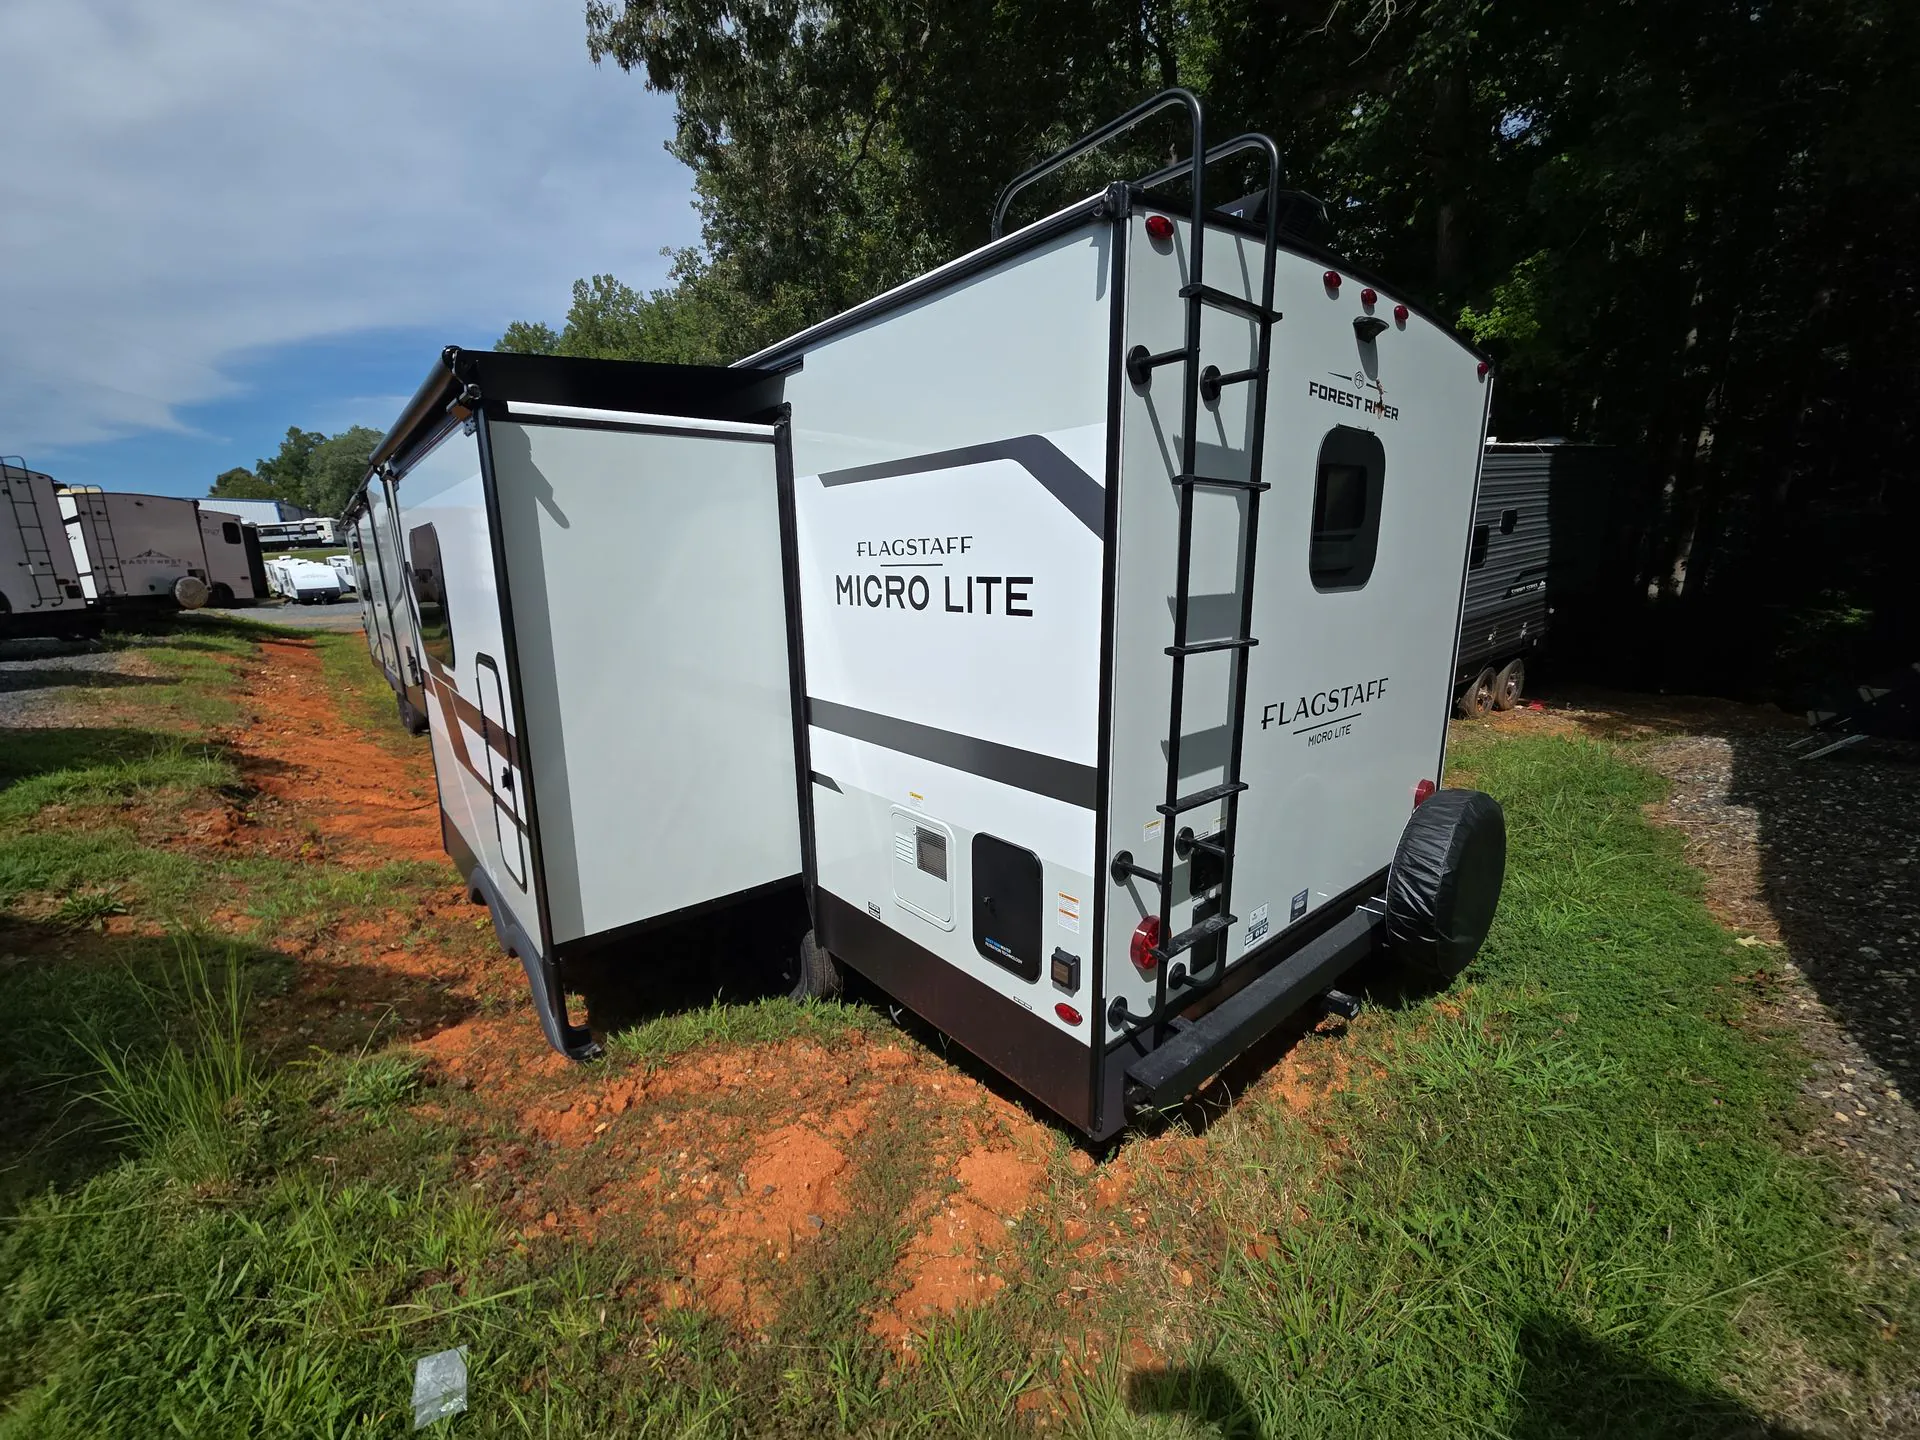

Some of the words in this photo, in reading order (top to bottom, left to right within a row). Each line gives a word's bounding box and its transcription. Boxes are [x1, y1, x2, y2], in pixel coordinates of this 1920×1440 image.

[1309, 381, 1362, 410] FOREST
[857, 536, 973, 557] FLAGSTAFF
[835, 574, 930, 611] MICRO
[944, 576, 1034, 617] LITE
[1260, 677, 1389, 730] FLAGSTAFF
[1307, 729, 1333, 747] MICRO
[1334, 724, 1352, 739] LITE
